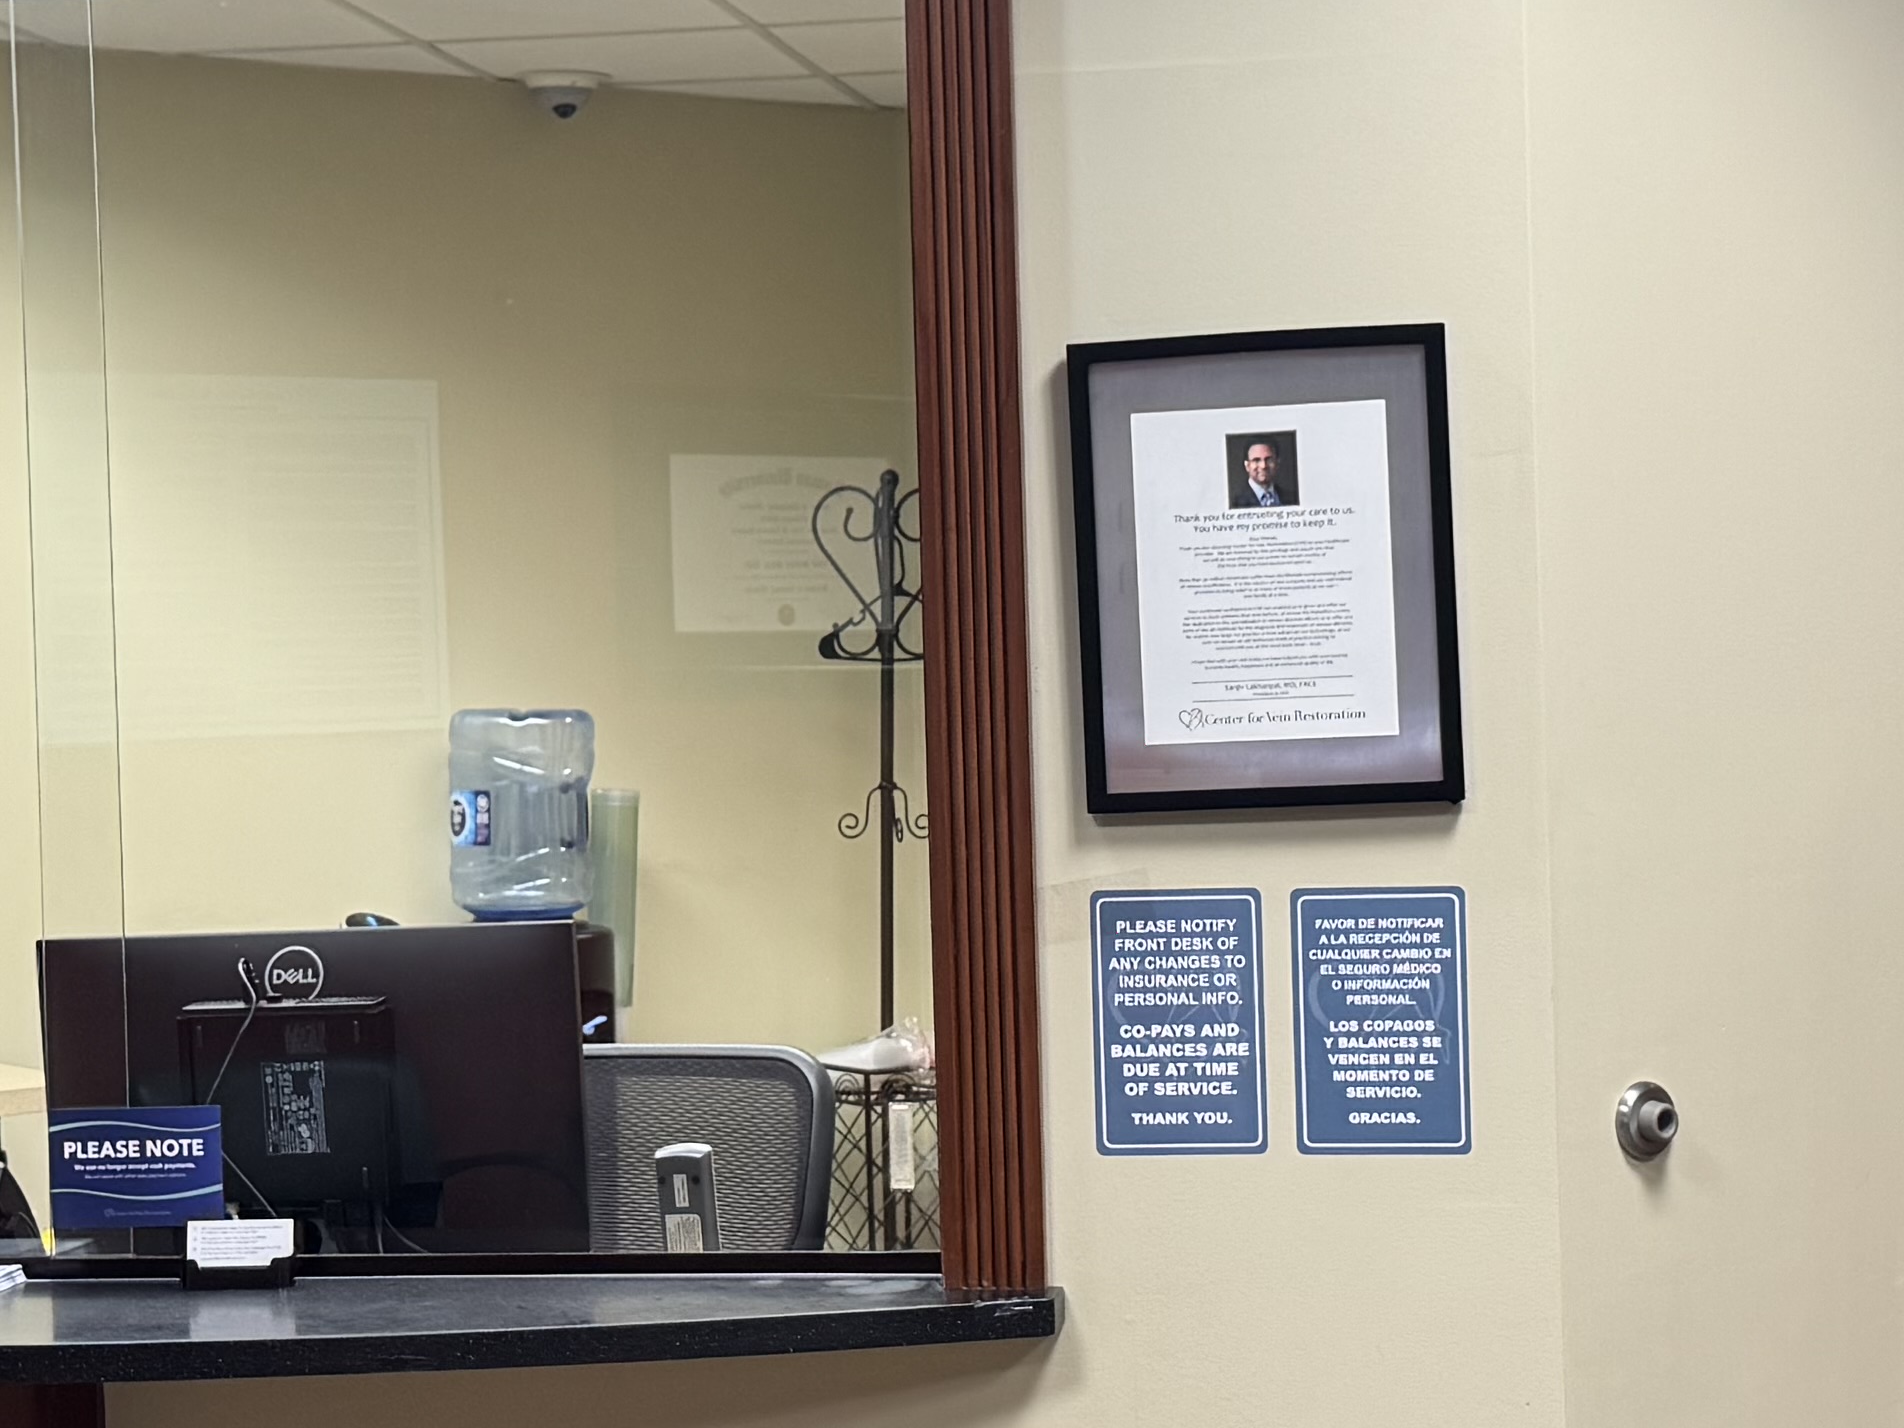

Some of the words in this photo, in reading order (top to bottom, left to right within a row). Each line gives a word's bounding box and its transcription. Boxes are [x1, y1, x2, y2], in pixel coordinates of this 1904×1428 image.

[1205, 713, 1243, 725] Center
[1248, 711, 1264, 724] for
[1295, 708, 1366, 721] Restoration
[1116, 920, 1176, 934] PLEASE
[1181, 919, 1236, 933] NOTIFY
[1315, 919, 1355, 929] FAVOR
[1358, 918, 1375, 929] DE
[1378, 917, 1444, 929] NOTIFICAR
[1115, 938, 1166, 951] FRONT
[1171, 937, 1213, 951] DESK
[1217, 937, 1239, 949] OF
[1319, 934, 1328, 944] A
[1331, 934, 1347, 944] LA
[1350, 931, 1420, 944] RECEPCIÓN
[1424, 933, 1440, 943] DE
[1309, 949, 1380, 960] CUALQUIER
[1383, 948, 1432, 959] CAMBIO
[1435, 948, 1451, 958] EN
[1109, 957, 1140, 970] ANY
[1145, 956, 1220, 969] CHANGES
[1225, 955, 1246, 968] TO
[1320, 964, 1336, 975] EL
[1338, 964, 1389, 975] SEGURO
[1393, 961, 1441, 974] MÉDICO
[273, 968, 317, 984] DELL
[1119, 974, 1209, 988] INSURANCE
[1214, 973, 1237, 986] OR
[1332, 980, 1342, 990] O
[1344, 976, 1430, 990] INFORMACIÓN
[1115, 992, 1199, 1006] PERSONAL
[1202, 992, 1243, 1005] INFO.
[1120, 1024, 1195, 1038] CO-PAYS
[1200, 1023, 1240, 1037] AND
[1330, 1021, 1358, 1032] LOS
[1363, 1020, 1435, 1032] COPAGOS
[1324, 1037, 1334, 1048] Y
[1338, 1037, 1418, 1048] BALANCES
[1422, 1037, 1442, 1048] SE
[1111, 1043, 1207, 1058] BALANCES
[1213, 1043, 1250, 1056] ARE
[1328, 1054, 1390, 1065] VENCEN
[1395, 1053, 1415, 1064] EN
[1420, 1053, 1438, 1064] EL
[1123, 1063, 1160, 1077] DUE
[1165, 1062, 1188, 1076] AT
[1193, 1062, 1239, 1076] TIME
[1333, 1070, 1410, 1082] MOMENTO
[1414, 1070, 1434, 1081] DE
[1124, 1082, 1149, 1096] OF
[1154, 1081, 1238, 1096] SERVICE.
[1346, 1086, 1421, 1098] SERVICIO.
[1131, 1112, 1189, 1125] THANK
[1193, 1112, 1233, 1124] YOU.
[1349, 1112, 1421, 1124] GRACIAS.
[64, 1140, 140, 1159] PLEASE
[146, 1139, 204, 1157] NOTE
